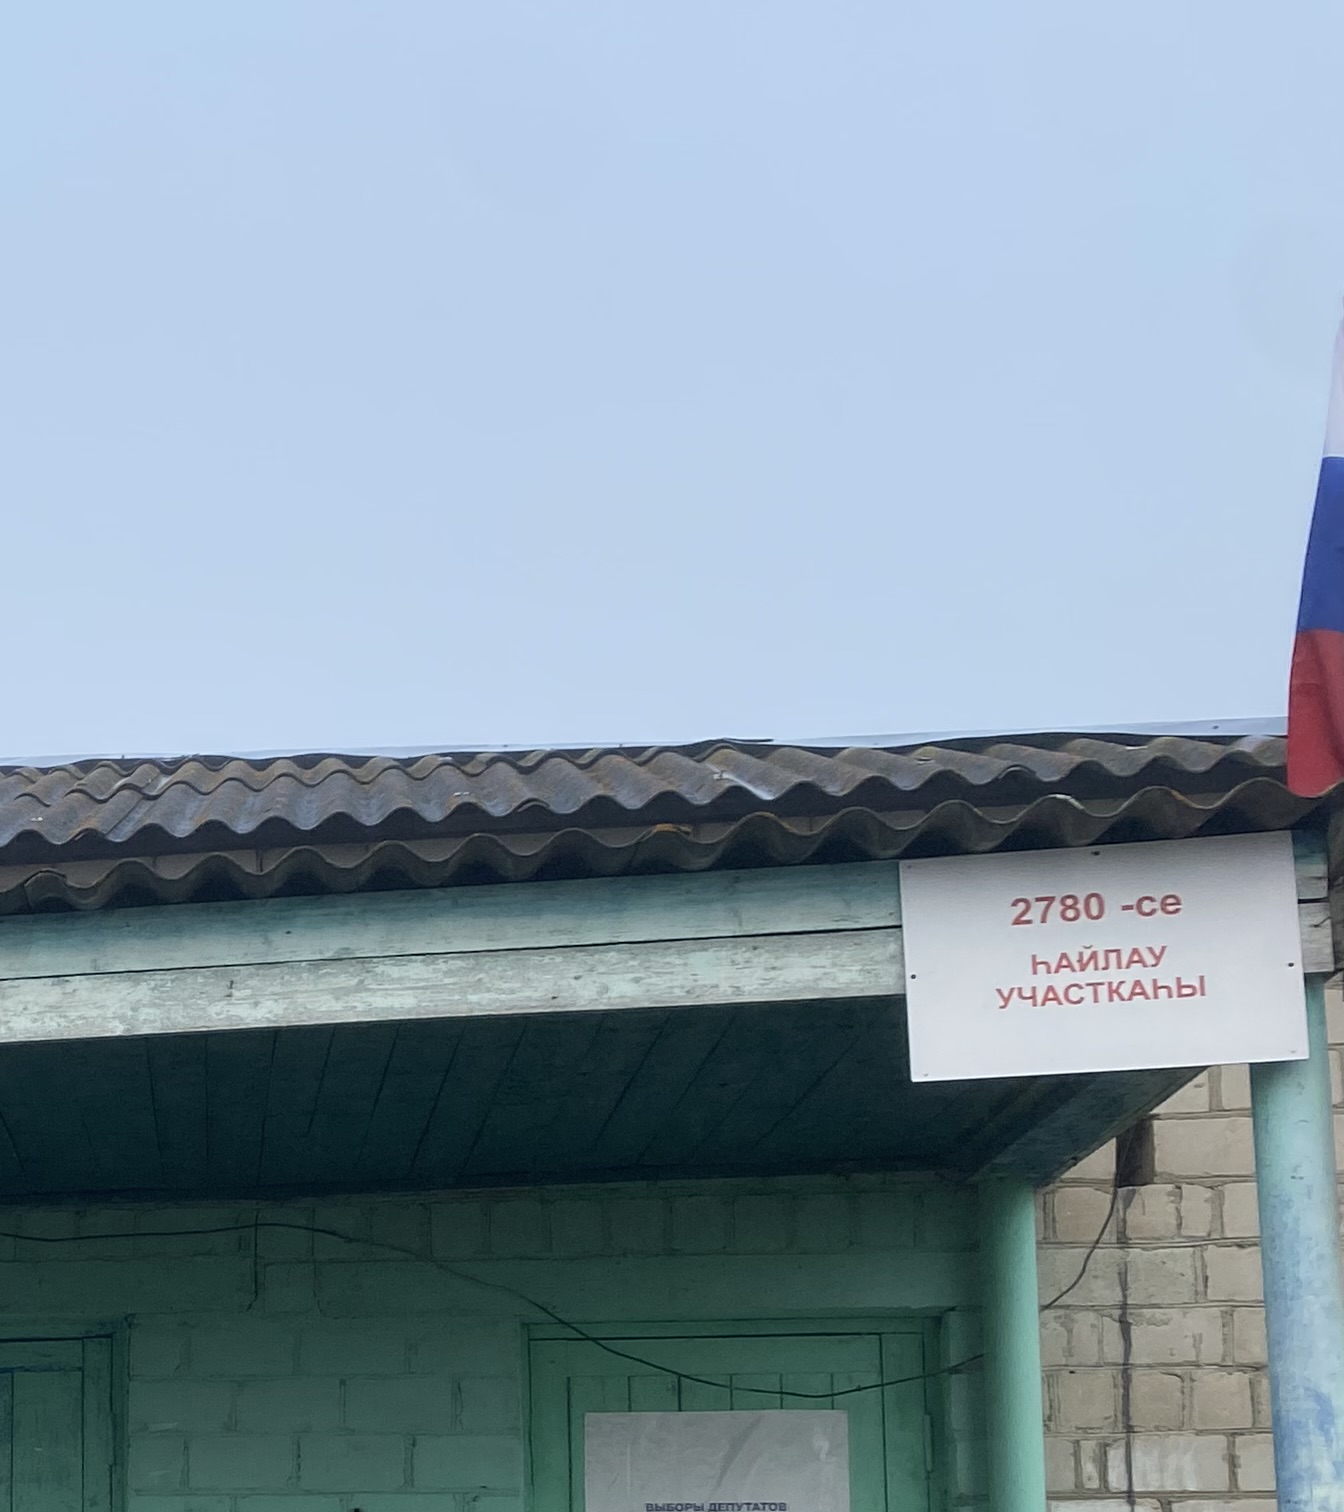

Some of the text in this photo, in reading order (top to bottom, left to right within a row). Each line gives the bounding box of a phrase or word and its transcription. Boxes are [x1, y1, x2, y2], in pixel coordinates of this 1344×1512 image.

[1010, 892, 1107, 926] 2780
[645, 1502, 788, 1512] ВЫБОРЫ ДЕПУТАТОВ
